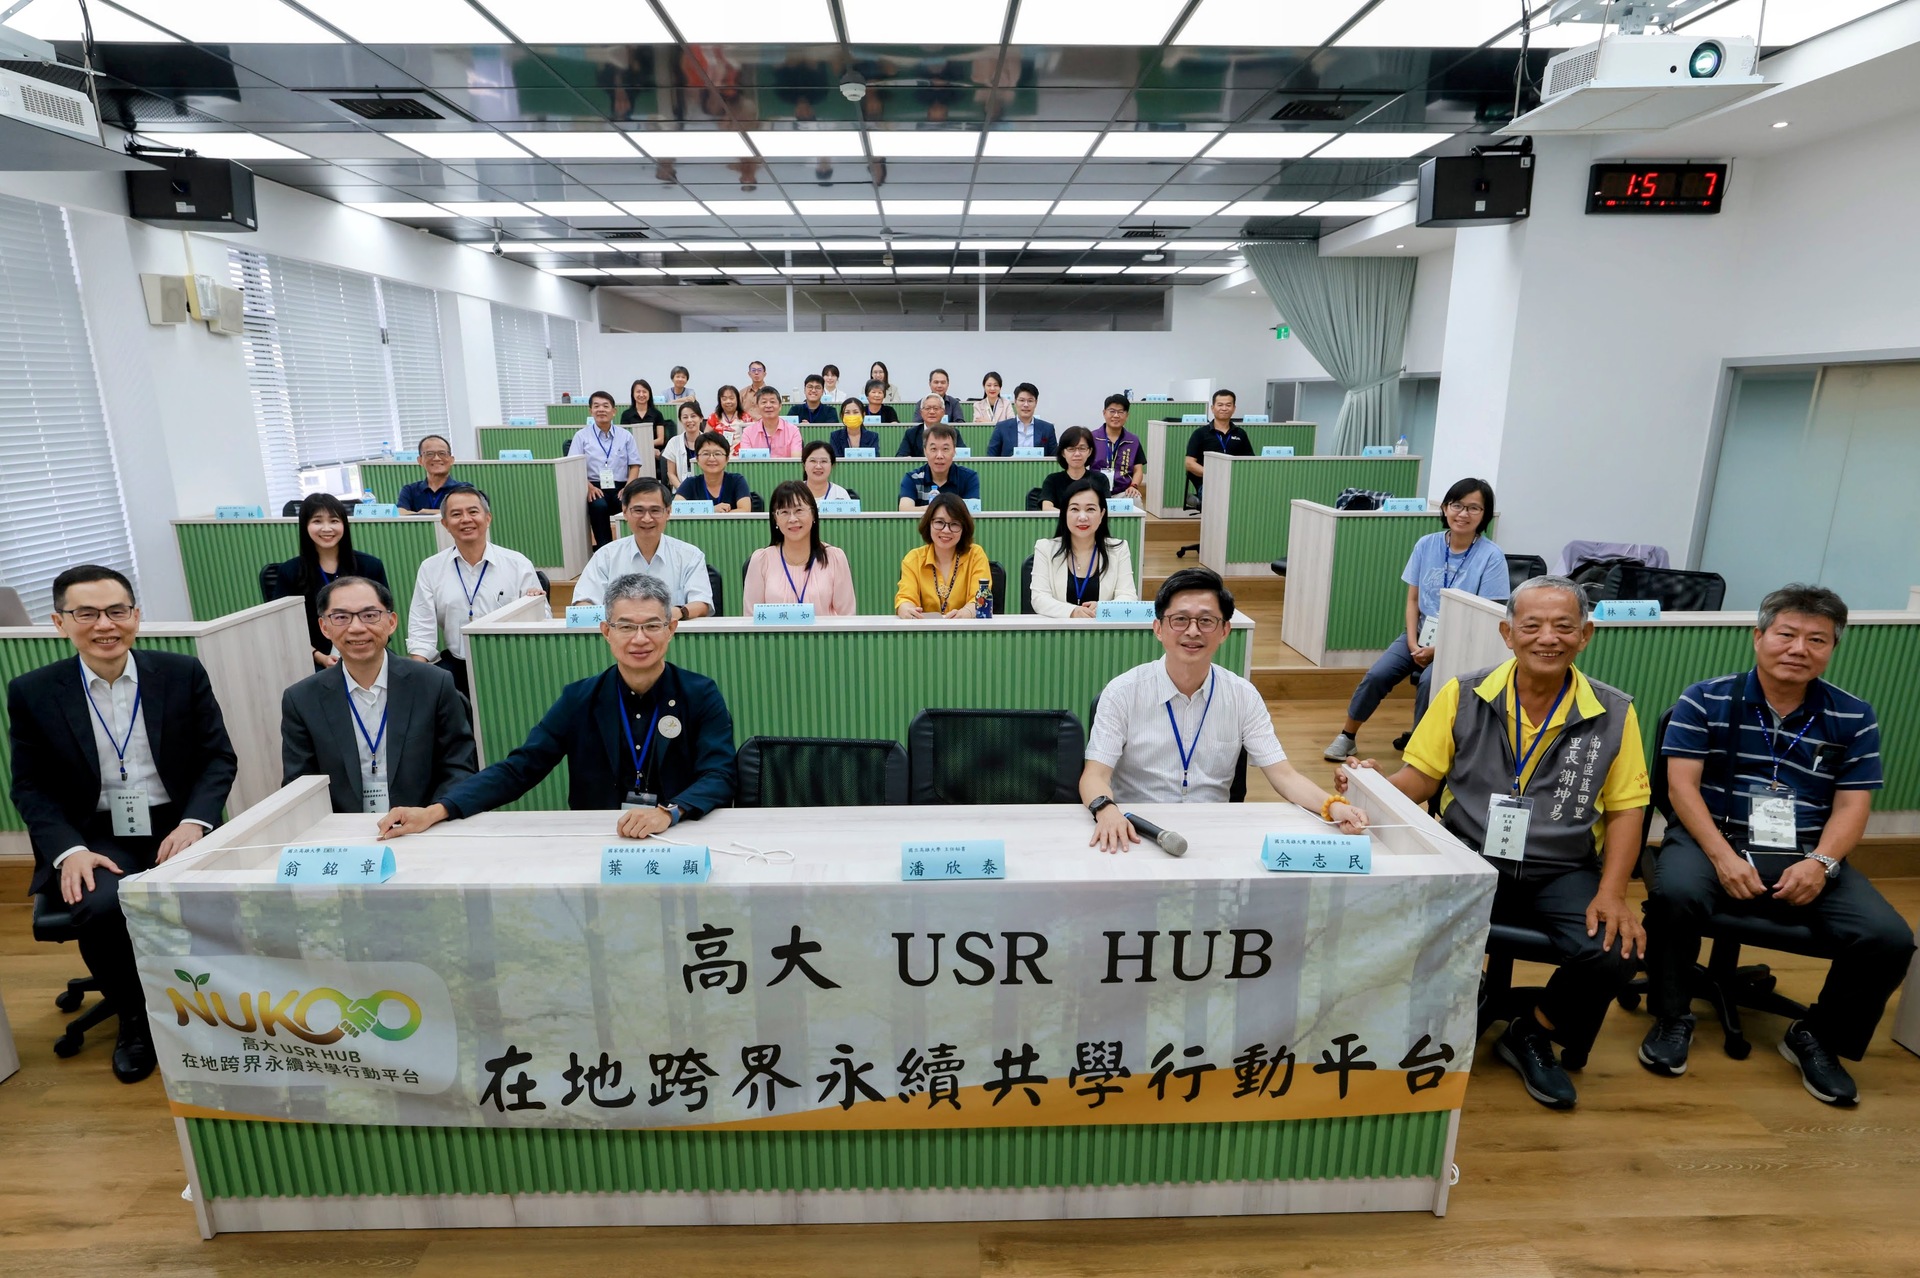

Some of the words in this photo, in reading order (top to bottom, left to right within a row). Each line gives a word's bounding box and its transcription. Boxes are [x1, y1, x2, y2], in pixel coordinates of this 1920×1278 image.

[1102, 608, 1154, 618] 張中原
[284, 859, 376, 877] 翁銘章
[608, 859, 699, 876] 葉俊顯
[909, 858, 998, 877] 潘欣泰
[682, 923, 842, 995] 高大
[891, 931, 1053, 987] USR
[1100, 928, 1273, 984] HUB
[240, 1036, 281, 1053] 高大
[281, 1042, 316, 1058] USR
[320, 1048, 361, 1063] HUB
[181, 1052, 420, 1085] 在地跨界永續共學行動平台
[479, 1033, 1456, 1114] 在地跨界永續共學行動平台
